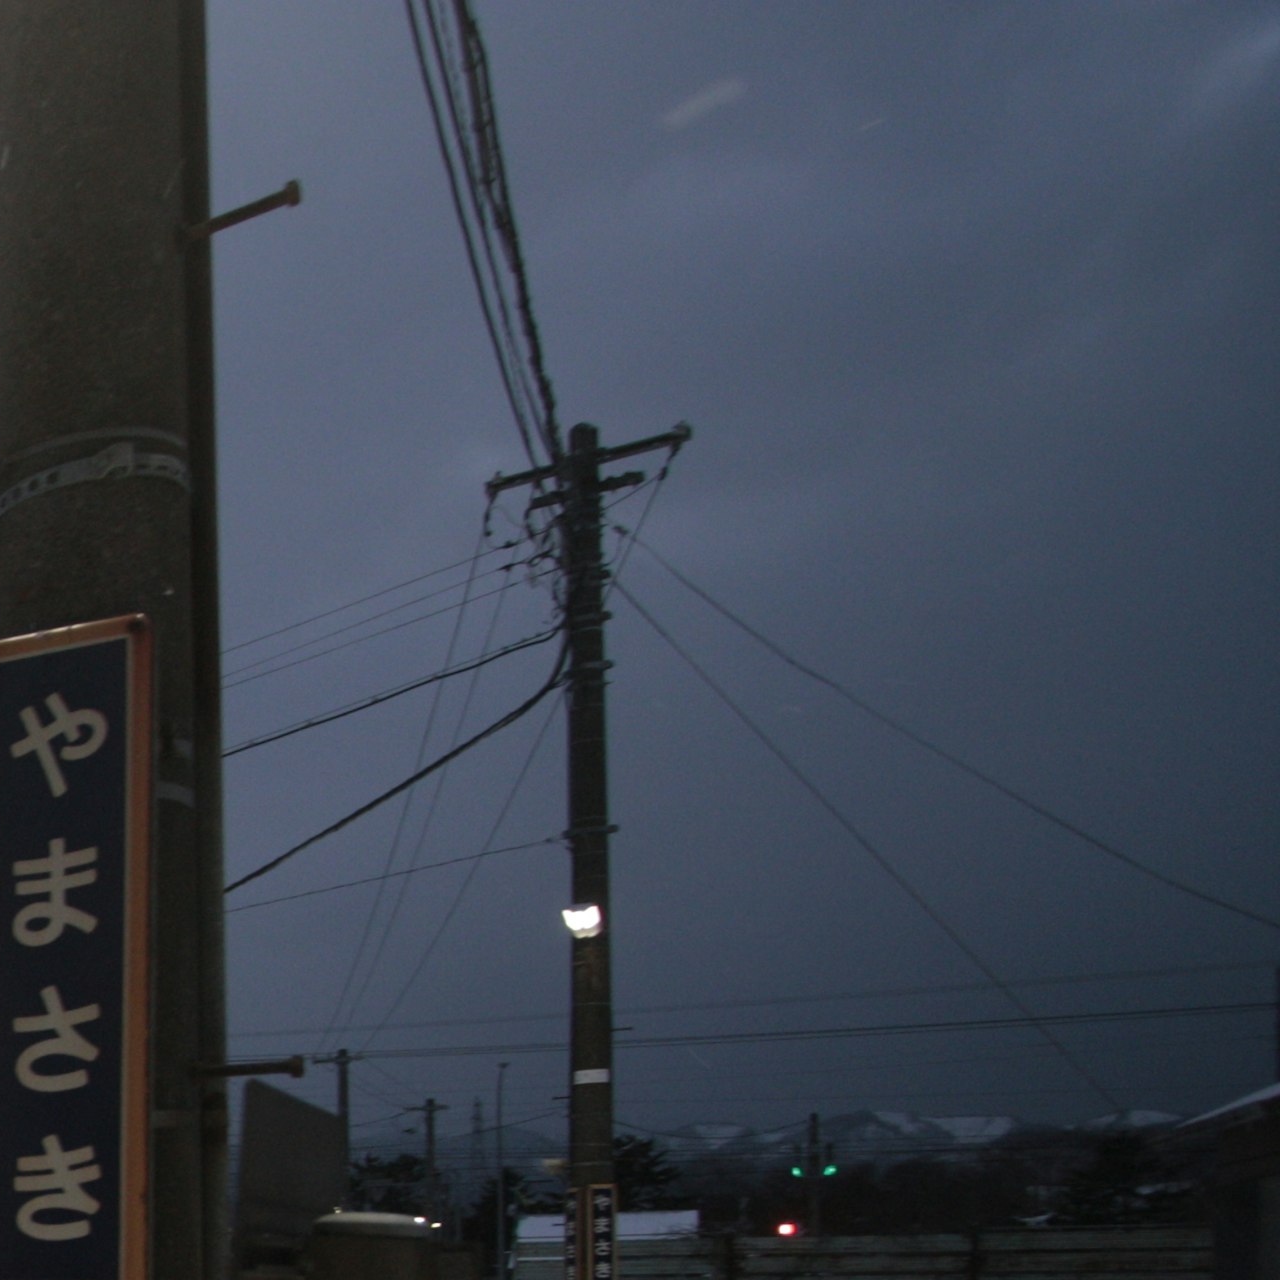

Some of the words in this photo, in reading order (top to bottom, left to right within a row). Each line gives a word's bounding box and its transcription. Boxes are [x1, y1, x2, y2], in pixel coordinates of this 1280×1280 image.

[8, 690, 110, 1242] やまさき
[592, 1193, 613, 1279] やまさき
